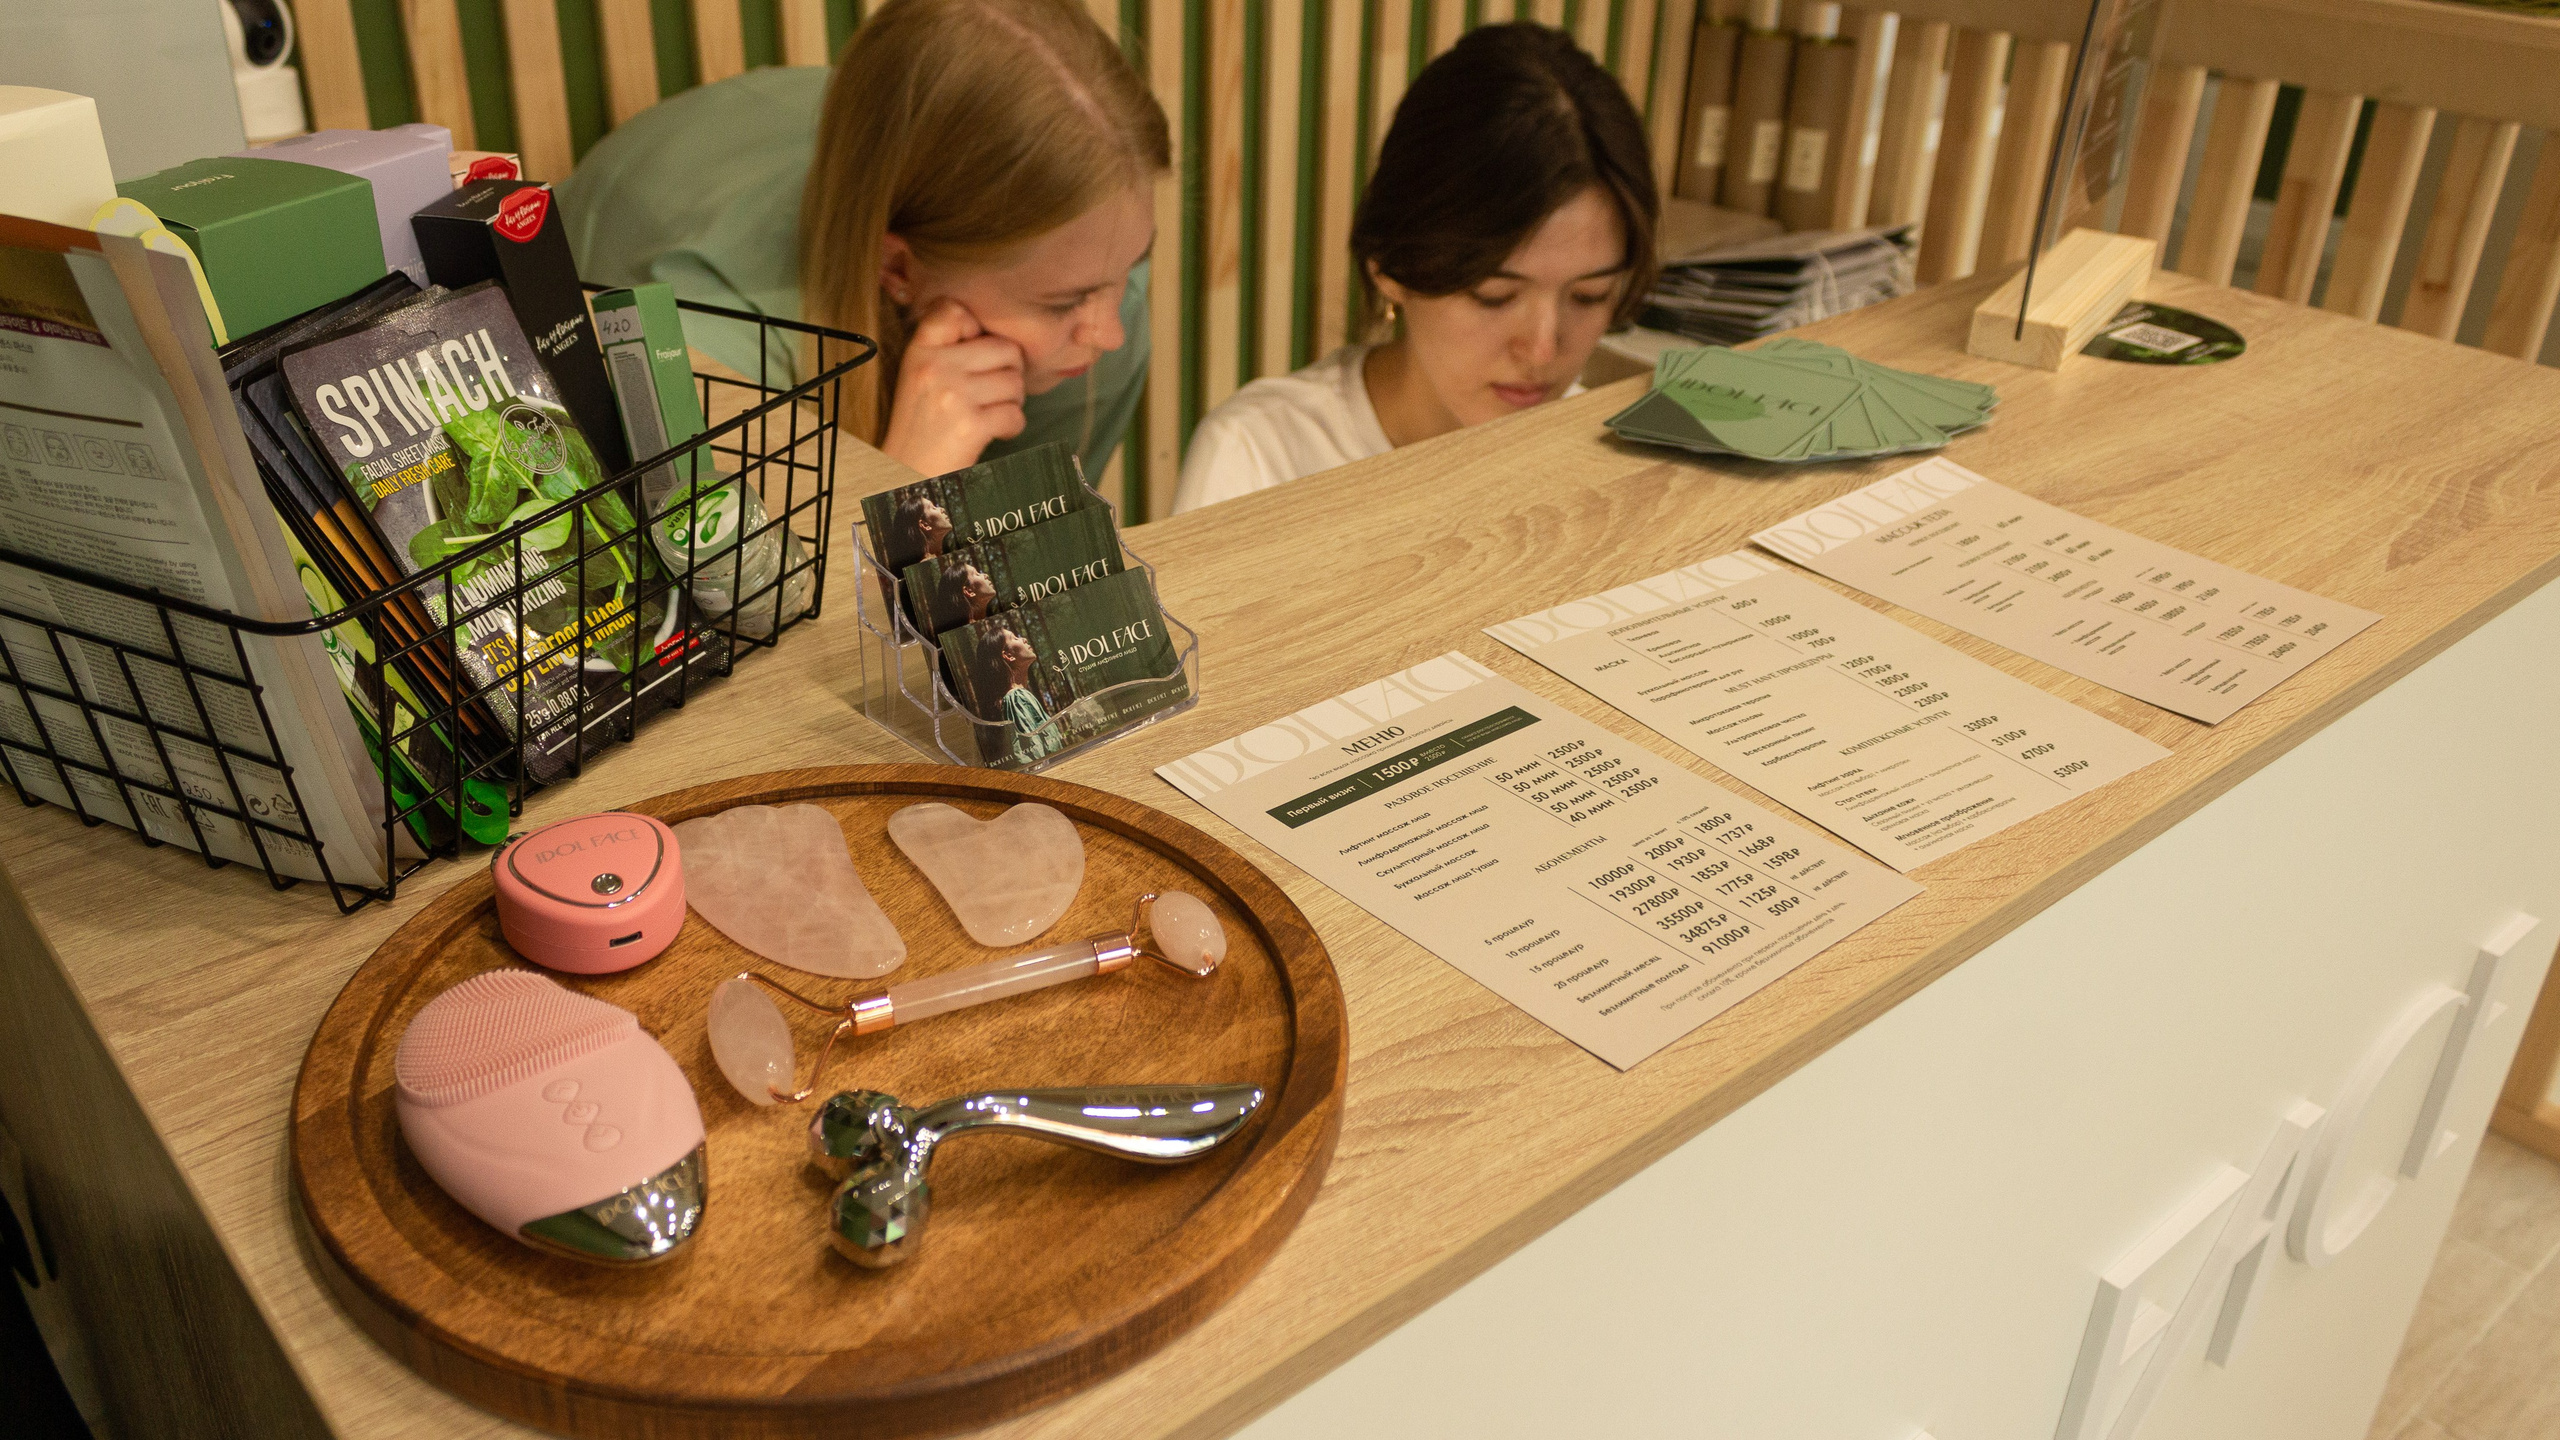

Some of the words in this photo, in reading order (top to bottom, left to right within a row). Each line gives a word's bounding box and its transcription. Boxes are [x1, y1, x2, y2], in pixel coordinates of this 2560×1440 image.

[602, 317, 632, 334] 420
[315, 328, 516, 458] SPINACH
[360, 457, 397, 482] FACIAL
[396, 443, 423, 467] SHEET
[422, 433, 451, 457] MASK
[371, 473, 403, 499] DAILY
[399, 462, 429, 488] FRESH
[428, 452, 455, 477] CARE
[985, 508, 1027, 538] IDOL
[1028, 494, 1070, 523] FACE
[1029, 571, 1070, 603] IDOL
[1071, 557, 1113, 587] FACE
[1070, 634, 1112, 665] IDOL
[1112, 618, 1153, 649] FACE
[1339, 725, 1405, 756] МЕНЮ
[1382, 784, 1435, 810] РАЗОВОЕ
[1430, 756, 1498, 789] ПОСЕЩЕНИЕ
[1493, 770, 1514, 783] 50
[1512, 759, 1542, 776] мин
[1511, 780, 1532, 793] 50
[1530, 769, 1560, 786] мин
[181, 780, 213, 801] 250
[1285, 795, 1329, 818] Первый
[1326, 784, 1356, 801] визит
[1529, 790, 1550, 803] 50
[1548, 778, 1578, 796] мин
[1548, 800, 1569, 814] 50
[1567, 788, 1597, 806] мин
[277, 814, 301, 824] OTHE
[1568, 810, 1587, 823] 40
[1586, 798, 1615, 816] мин
[535, 839, 586, 865] IDOL
[590, 827, 641, 849] FACE
[1337, 835, 1376, 856] Лифтинг
[1374, 820, 1411, 839] массаж
[1409, 811, 1432, 824] лица
[1356, 827, 1436, 867] Лимфодренажный
[1434, 813, 1469, 832] массаж
[1467, 803, 1489, 816] лица
[1374, 846, 1437, 878] Скульптурный
[1434, 831, 1470, 851] массаж
[1468, 822, 1491, 835] лица
[1392, 862, 1445, 890] Буккальный
[1442, 847, 1479, 867] массаж
[1533, 834, 1608, 874] АБОНЕМЕНТЫ
[1412, 880, 1452, 902] Массаж
[1450, 870, 1473, 884] лица
[1468, 857, 1500, 874] Гуаша
[1482, 938, 1493, 946] 5
[1490, 917, 1535, 943] процедур
[1504, 949, 1519, 959] 10
[1516, 928, 1561, 954] процедур
[1527, 964, 1543, 974] 15
[1539, 942, 1585, 969] процедур
[1552, 979, 1568, 990] 20
[1564, 957, 1610, 984] процедур
[1631, 954, 1662, 973] месяц
[1653, 962, 1690, 985] полгода
